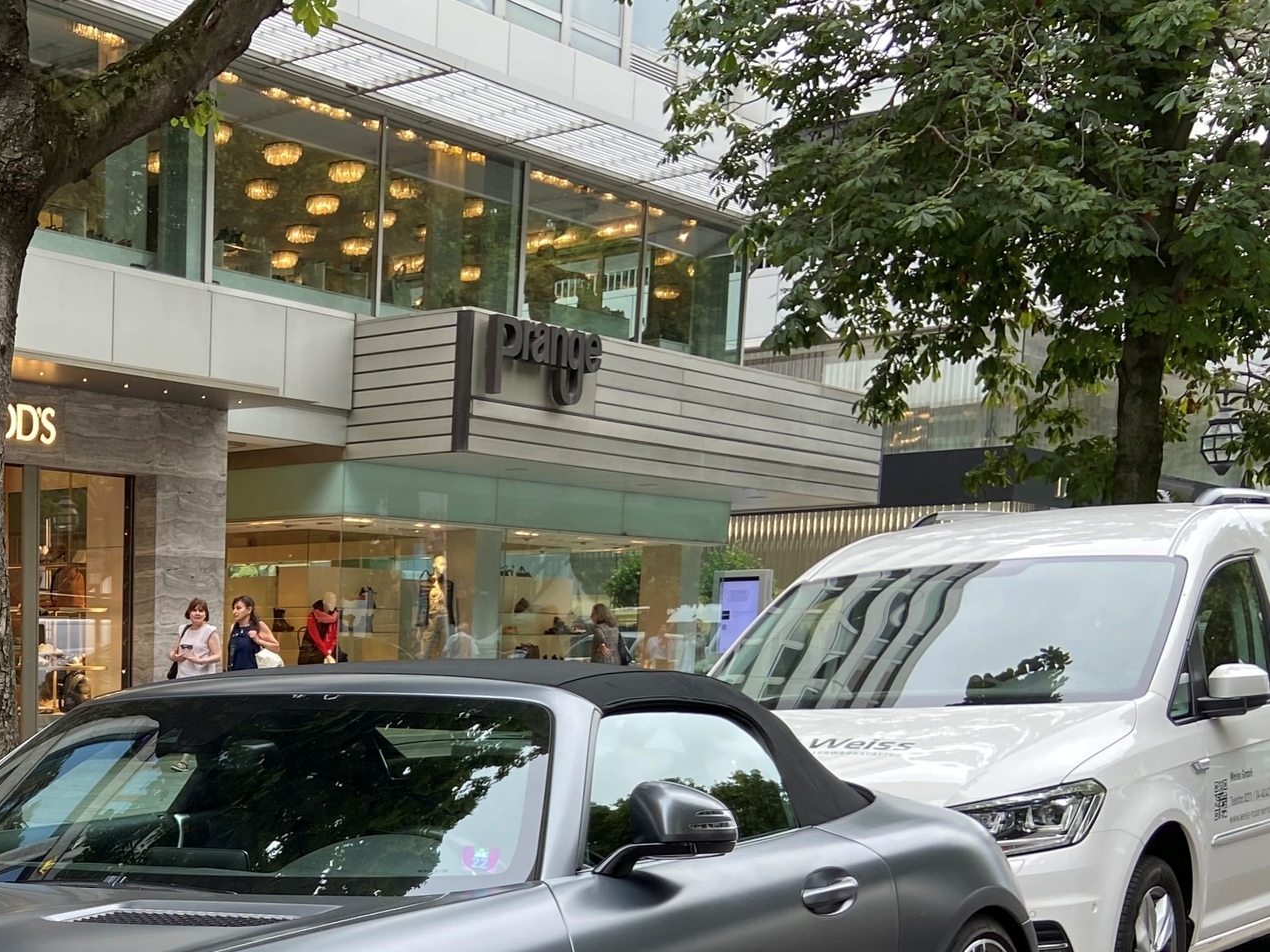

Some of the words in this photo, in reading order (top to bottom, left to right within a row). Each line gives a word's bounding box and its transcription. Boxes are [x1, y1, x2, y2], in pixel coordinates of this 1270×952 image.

[486, 314, 602, 406] prange
[5, 403, 57, 445] D'S
[809, 738, 916, 751] Weiss
